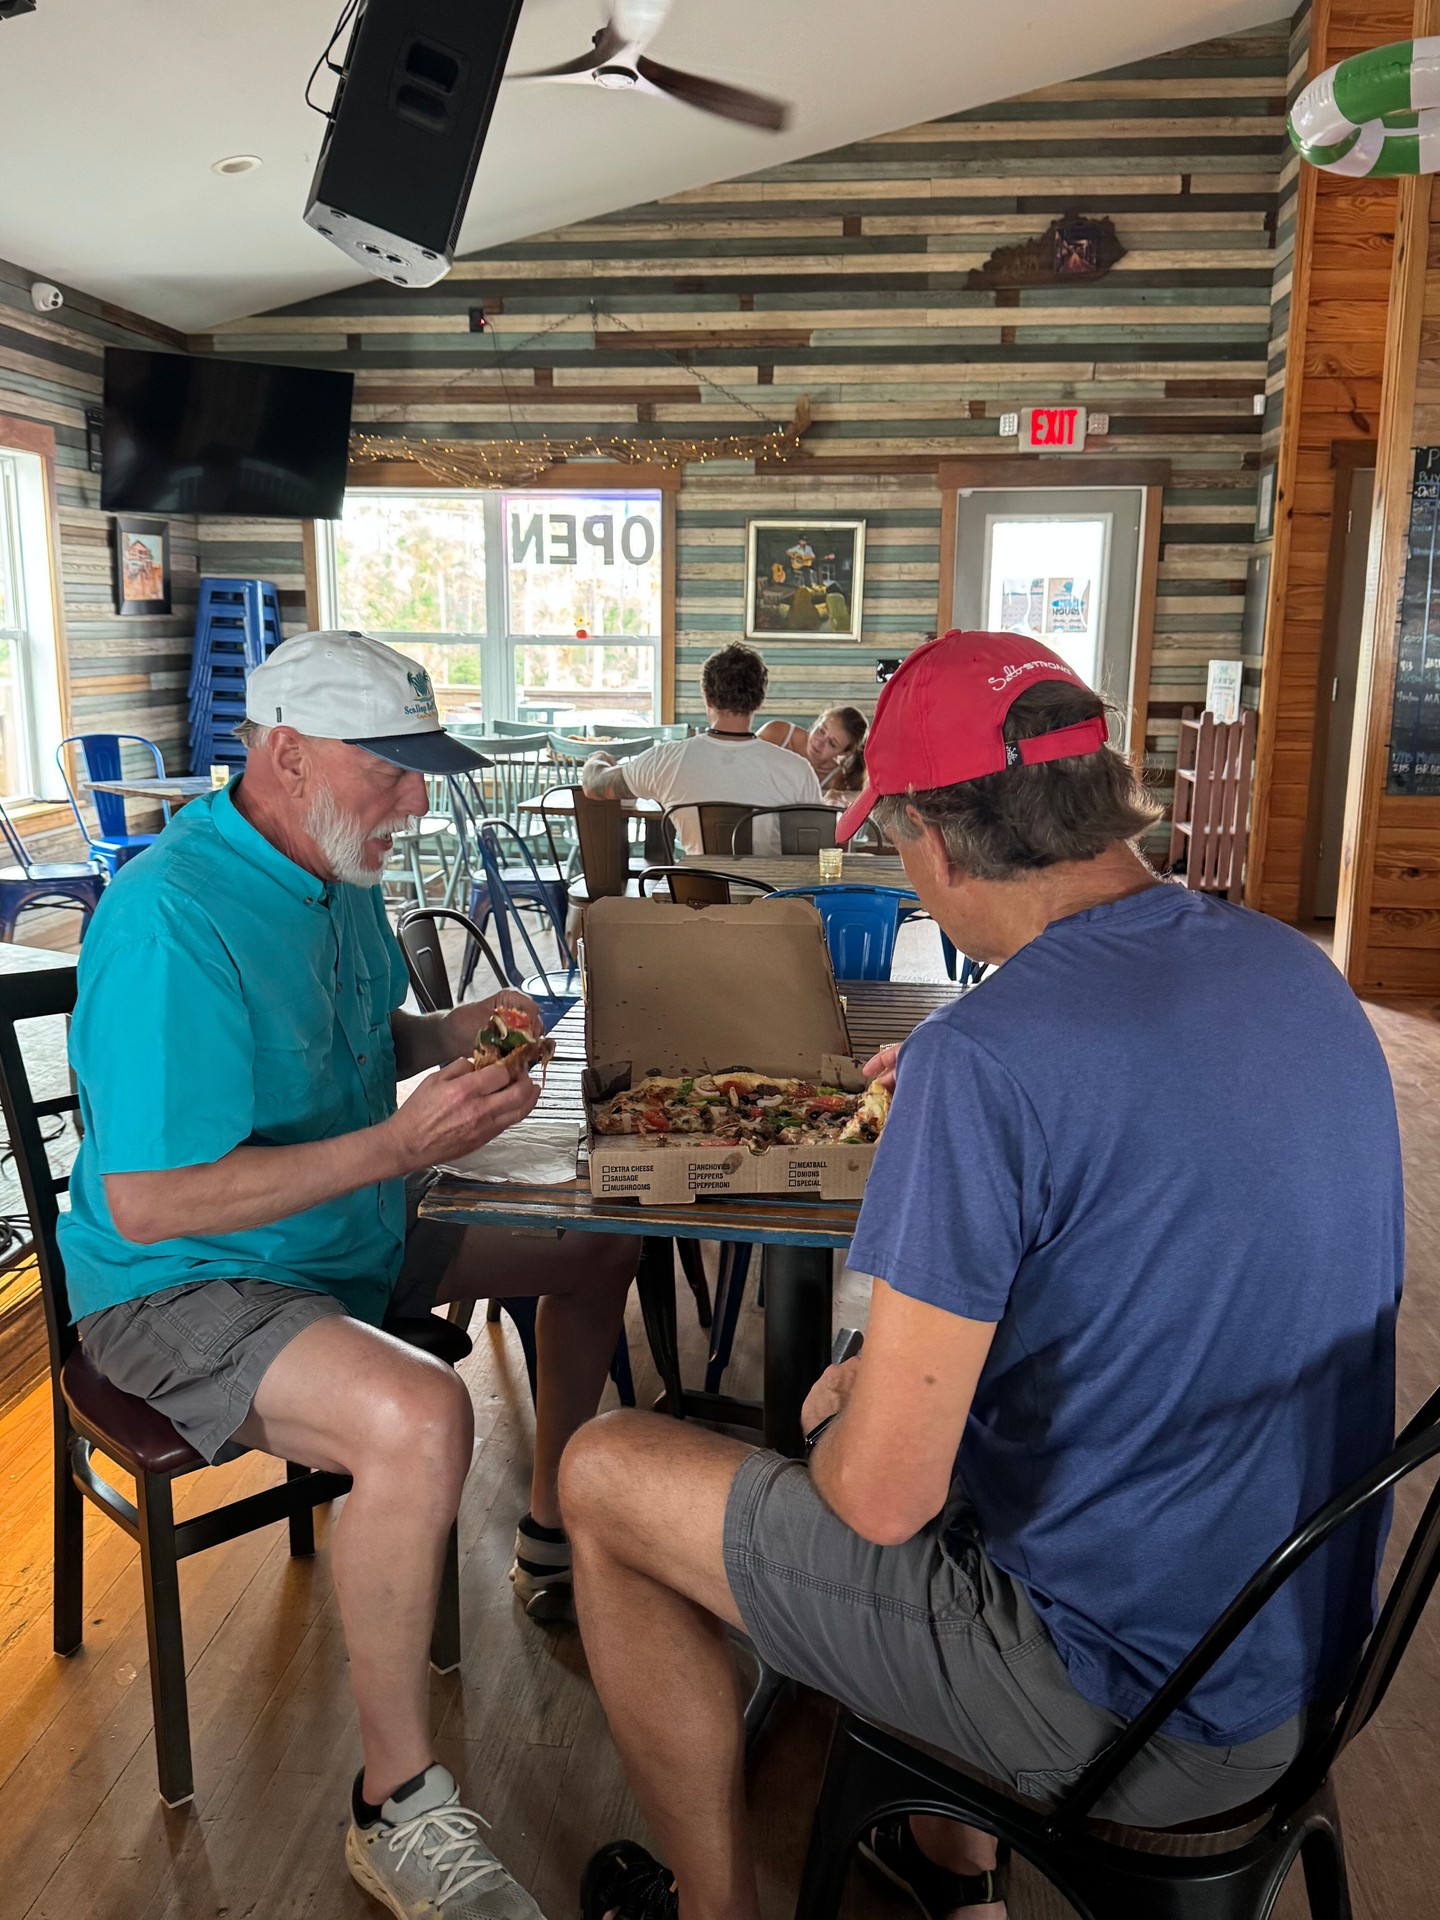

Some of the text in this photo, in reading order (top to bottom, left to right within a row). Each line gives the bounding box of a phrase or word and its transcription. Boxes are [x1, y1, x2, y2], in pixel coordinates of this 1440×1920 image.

[1030, 408, 1078, 446] EXIT
[610, 1165, 630, 1173] EXTRA
[796, 1161, 828, 1169] MEATBALL
[796, 1170, 820, 1178] ONIONS
[610, 1183, 651, 1191] MUSHROOMS
[696, 1181, 730, 1189] PEPPERONI
[796, 1179, 821, 1187] SPECIAL
